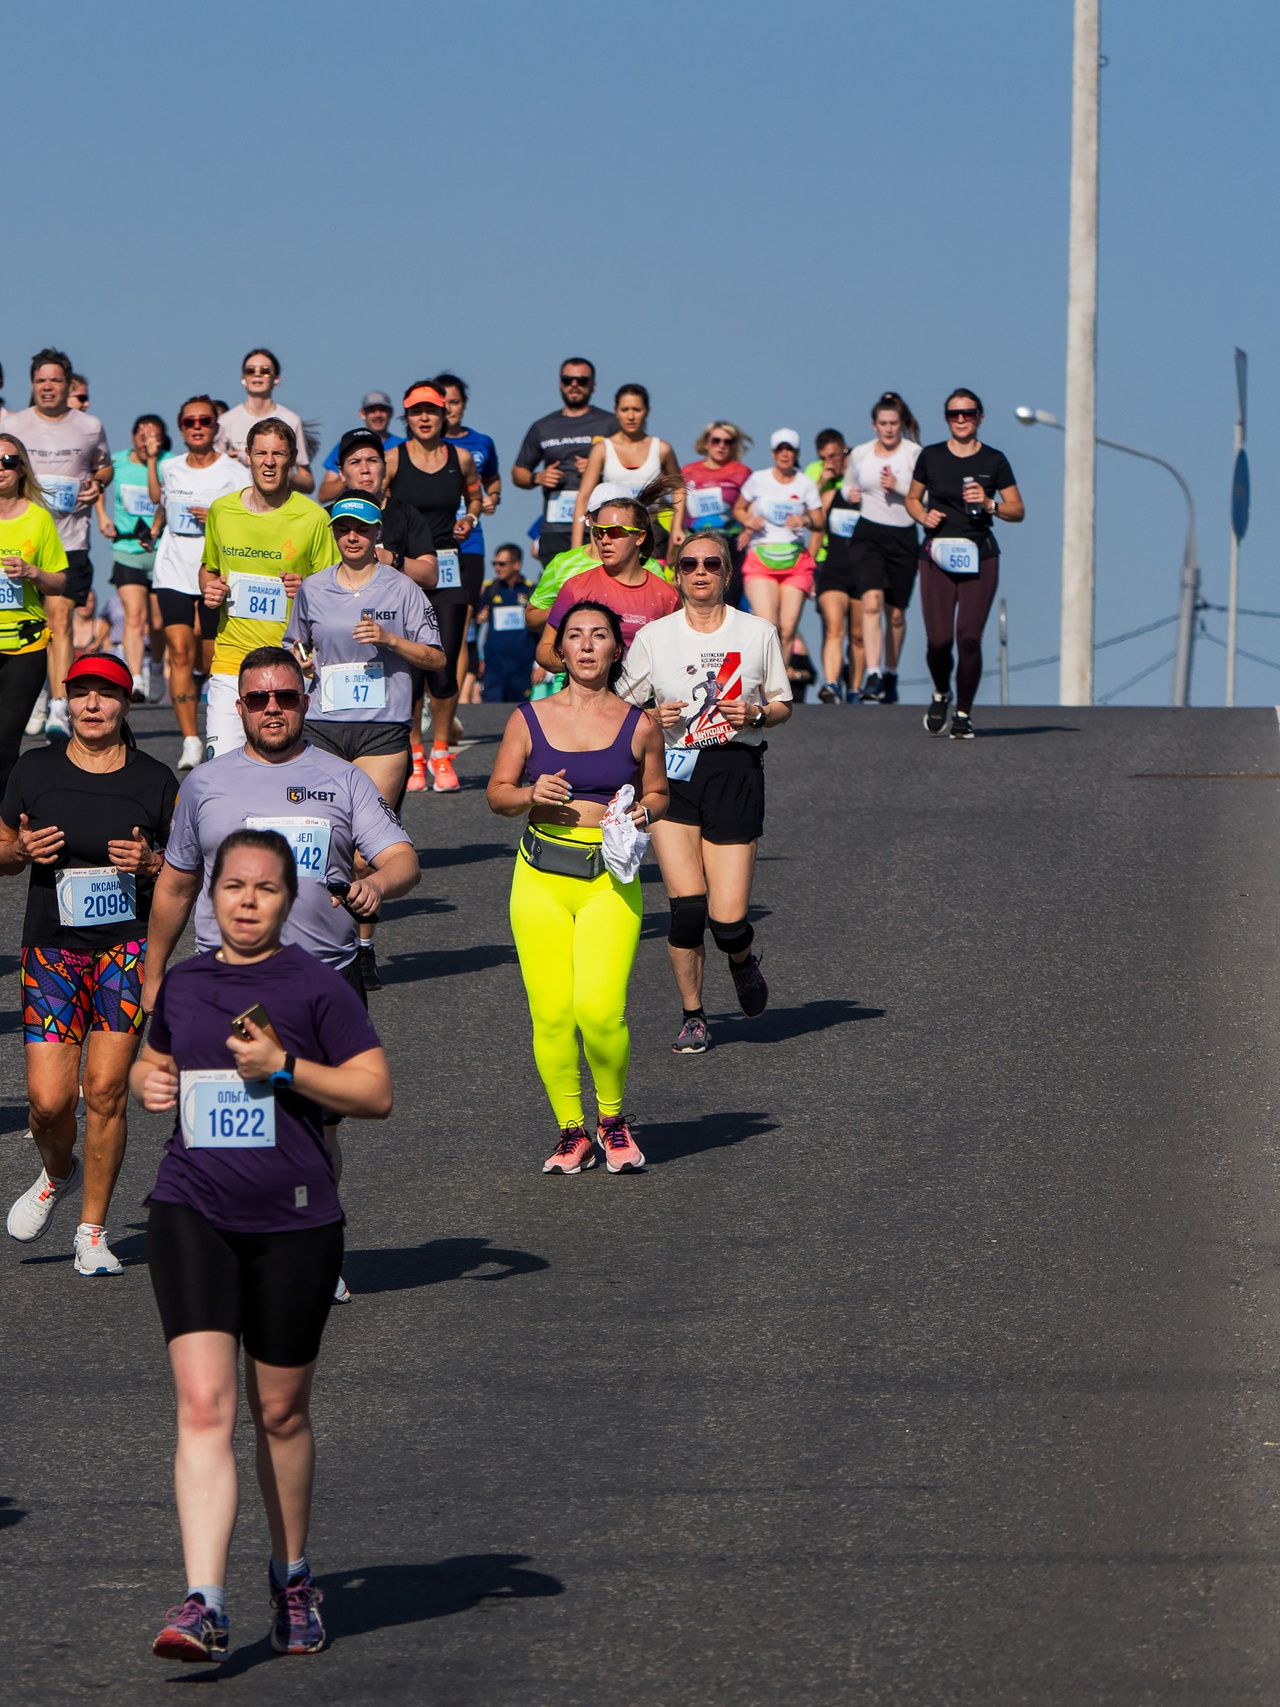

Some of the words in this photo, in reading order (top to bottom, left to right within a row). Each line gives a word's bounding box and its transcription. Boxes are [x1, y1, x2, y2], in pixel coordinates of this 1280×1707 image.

[222, 545, 282, 560] AstraZeneca
[949, 554, 970, 568] 560
[247, 585, 281, 596] АФАНАСИЙ
[249, 596, 276, 615] 841
[345, 675, 375, 683] ВЛЕРИЯ
[352, 686, 369, 702] 47
[665, 752, 686, 773] 17
[296, 833, 313, 843] ВЕЛ
[91, 880, 122, 893] ОКСАНА
[84, 892, 129, 918] 2098
[218, 1091, 250, 1104] ОЛЬГА
[209, 1108, 265, 1137] 1622
